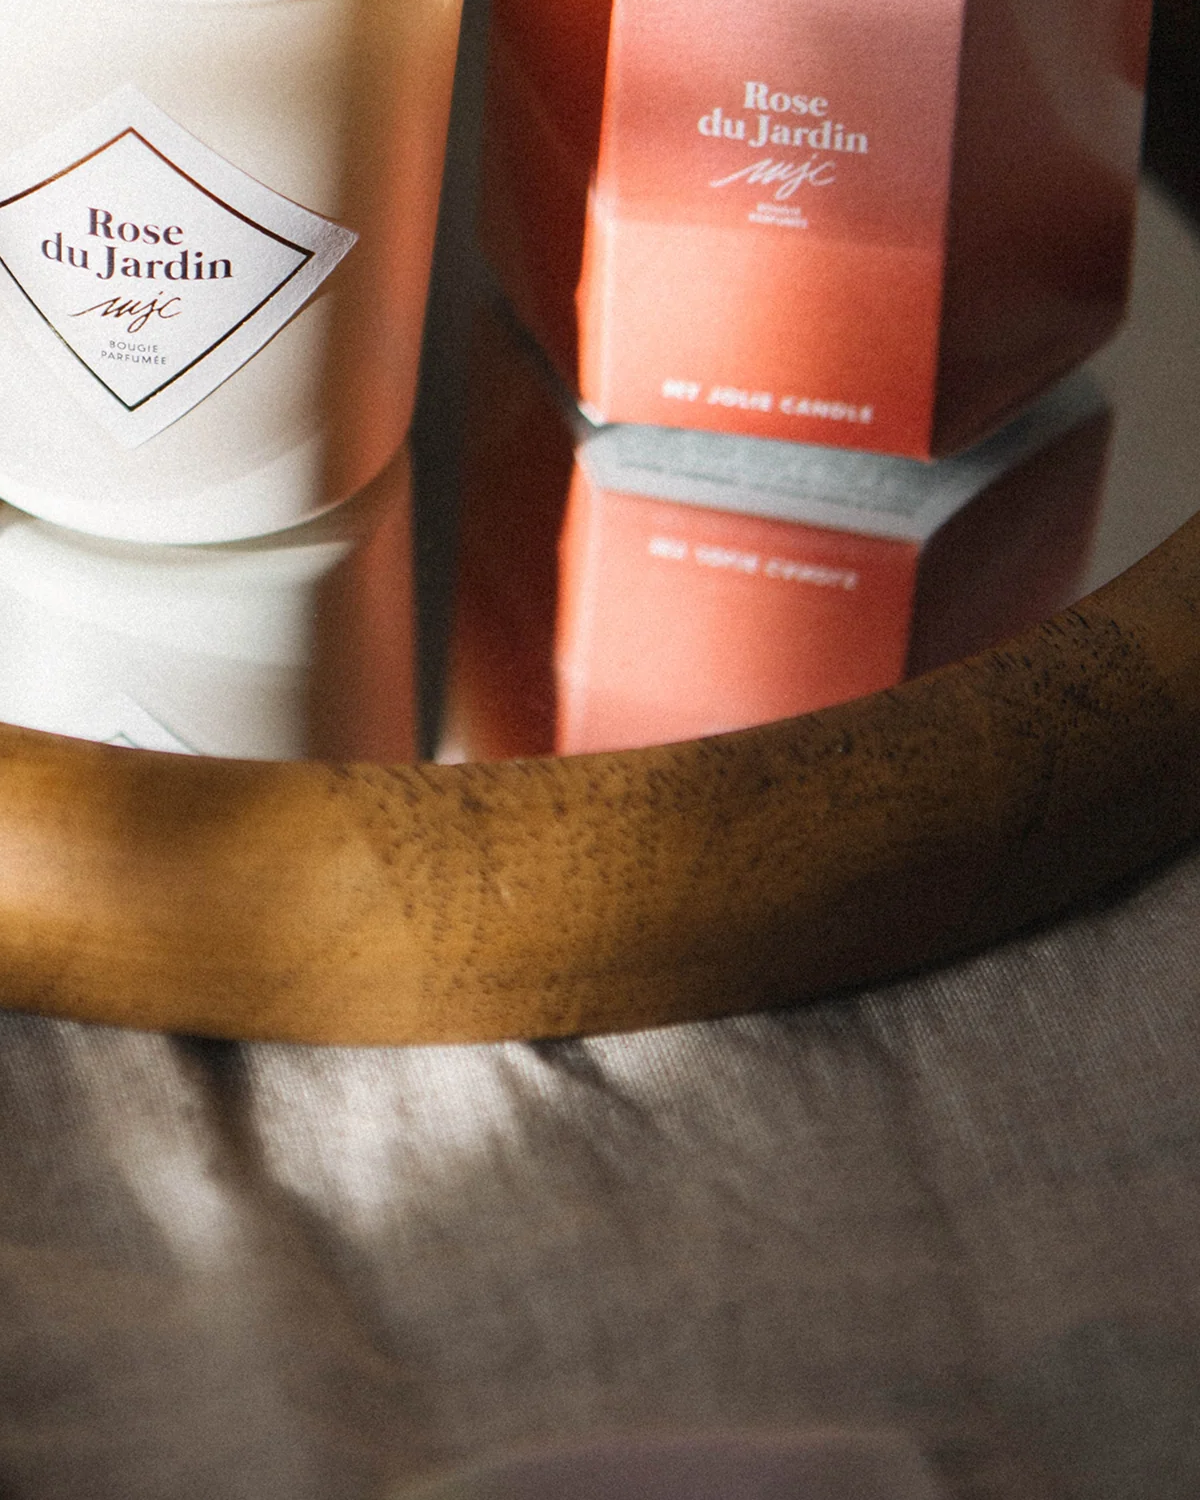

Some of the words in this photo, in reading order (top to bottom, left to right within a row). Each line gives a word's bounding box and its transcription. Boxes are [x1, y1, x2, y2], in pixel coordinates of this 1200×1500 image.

[743, 81, 829, 117] Rose
[697, 107, 745, 140] du
[748, 114, 869, 155] Jardin
[87, 207, 184, 246] Rose
[40, 232, 88, 270] du
[97, 246, 233, 281] Jardin
[100, 349, 167, 366] PARFUMÉE
[109, 339, 159, 354] BOUGIE
[779, 396, 874, 425] CANDLE
